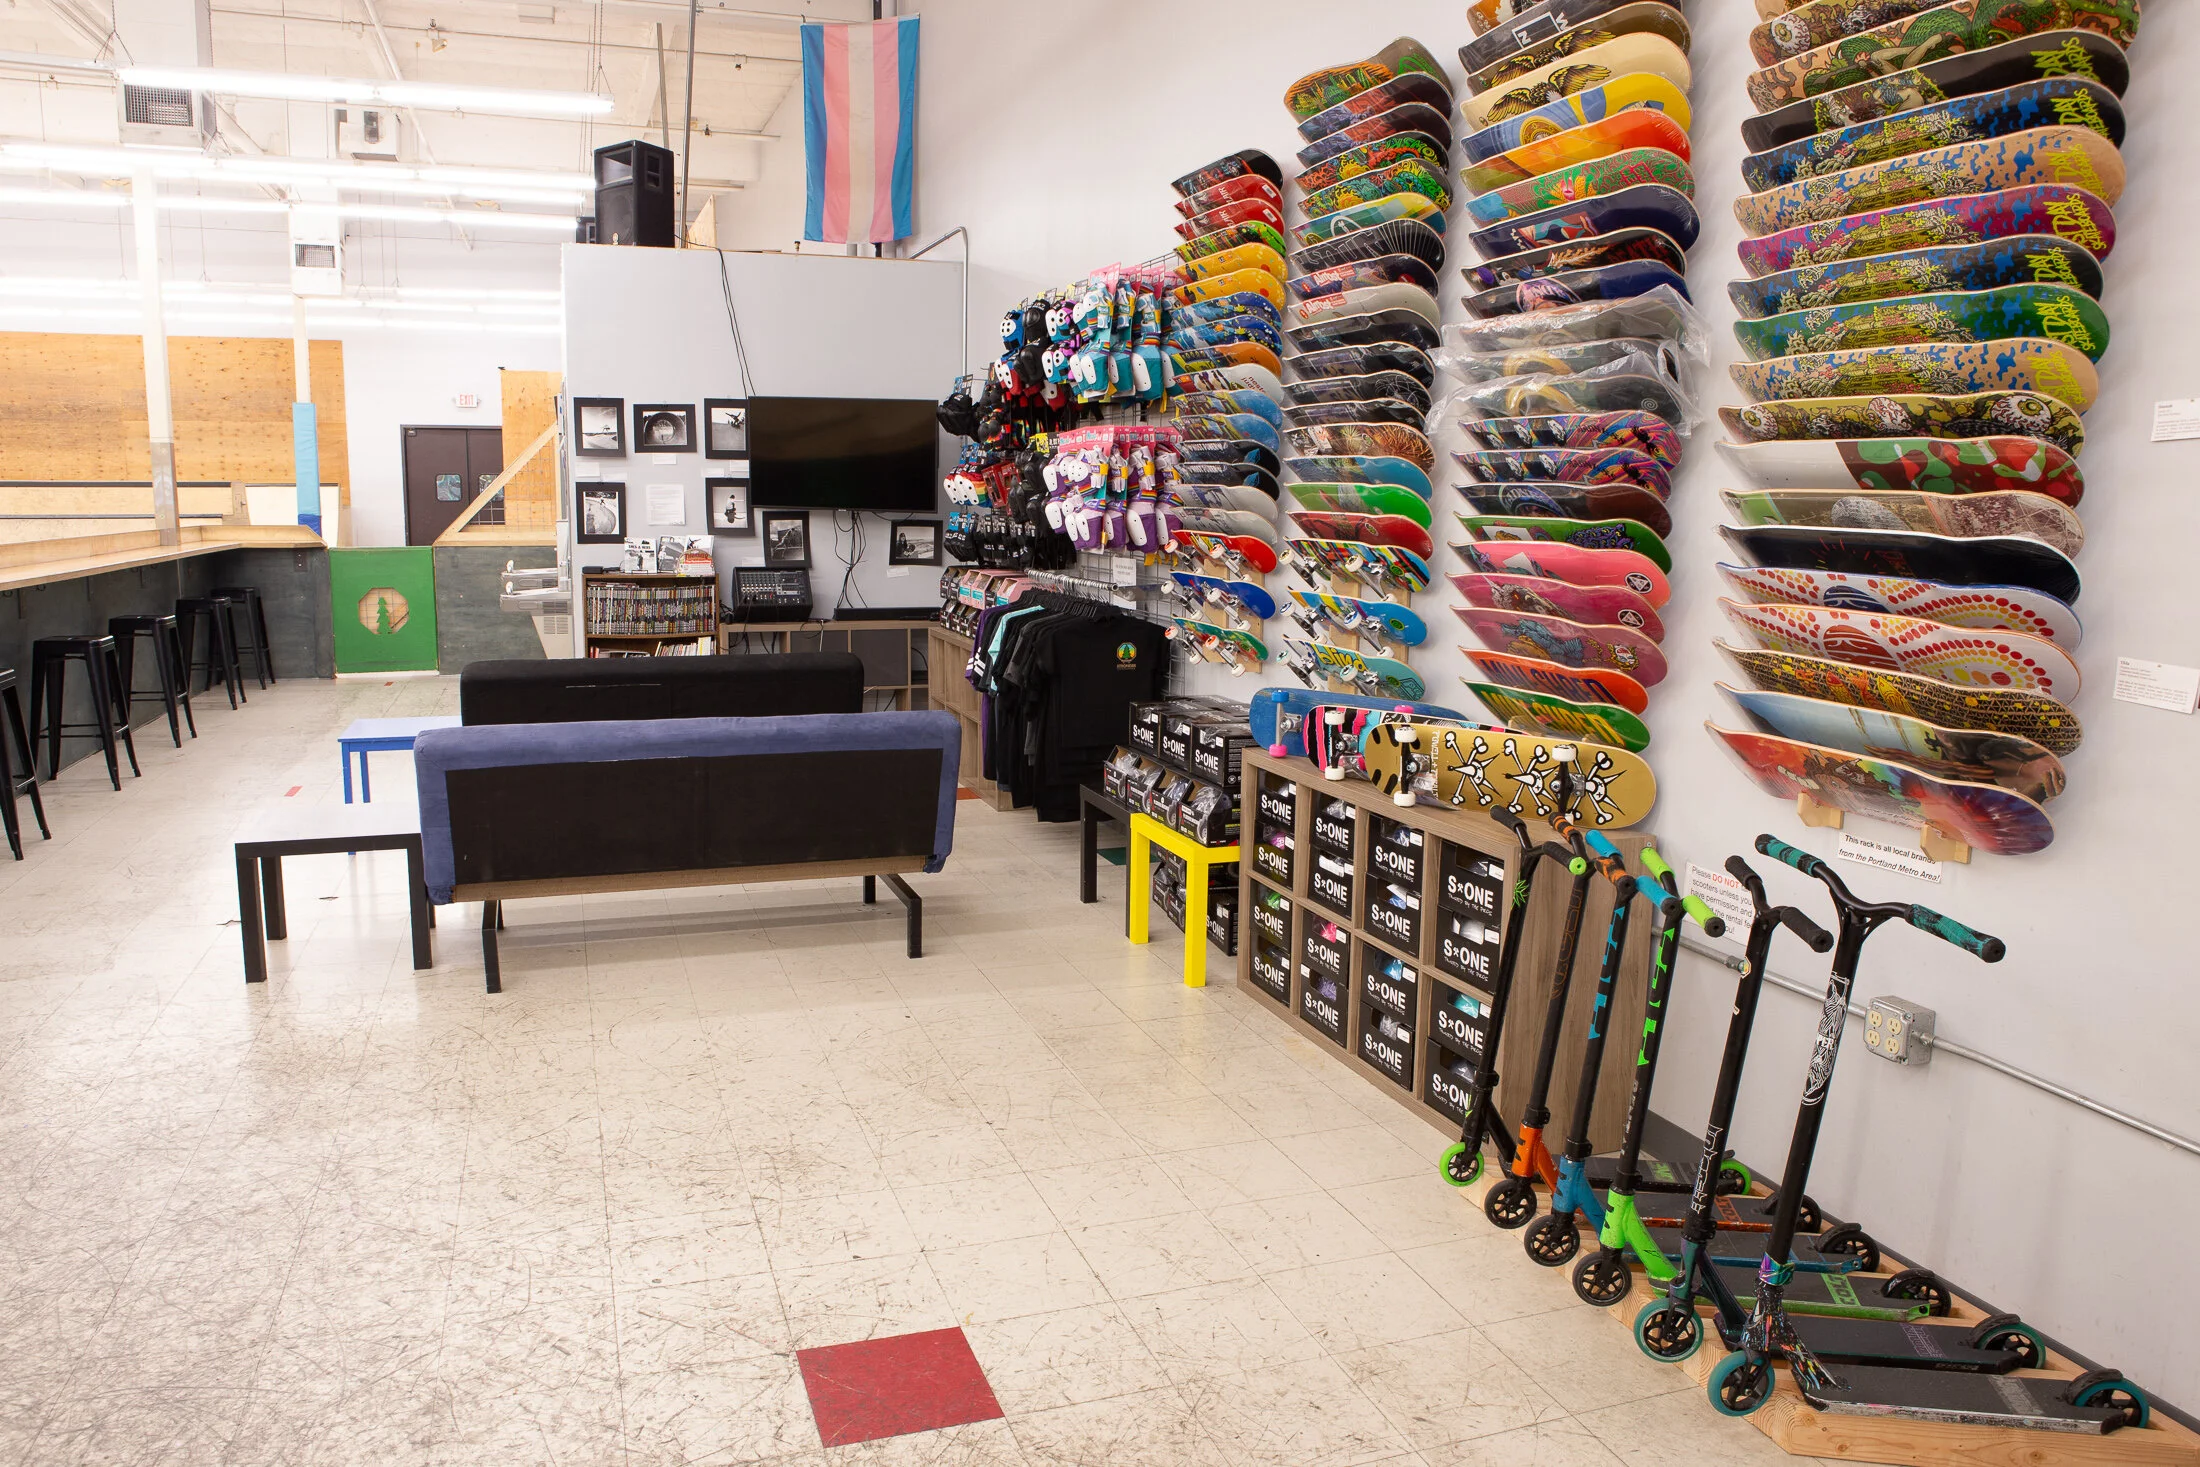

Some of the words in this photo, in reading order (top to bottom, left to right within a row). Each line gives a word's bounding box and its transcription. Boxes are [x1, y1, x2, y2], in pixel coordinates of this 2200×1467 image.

[460, 395, 473, 405] EXIT
[1310, 643, 1369, 673] blind
[1845, 834, 1859, 844] This
[1860, 840, 1875, 849] rack
[1876, 843, 1882, 851] is
[1883, 845, 1892, 853] all
[1892, 848, 1910, 857] local
[1838, 848, 1855, 858] from
[1855, 853, 1867, 862] the
[1867, 856, 1897, 870] Portland
[1897, 864, 1919, 877] Metro
[1920, 871, 1940, 882] Area!
[1692, 865, 1711, 879] Please
[1712, 873, 1723, 884] DO
[1724, 878, 1739, 889] NOT
[1692, 879, 1719, 894] scooters
[1719, 888, 1739, 901] unless
[1740, 896, 1752, 906] you
[1706, 895, 1739, 913] permission
[1740, 908, 1752, 918] and
[1725, 914, 1743, 926] rental
